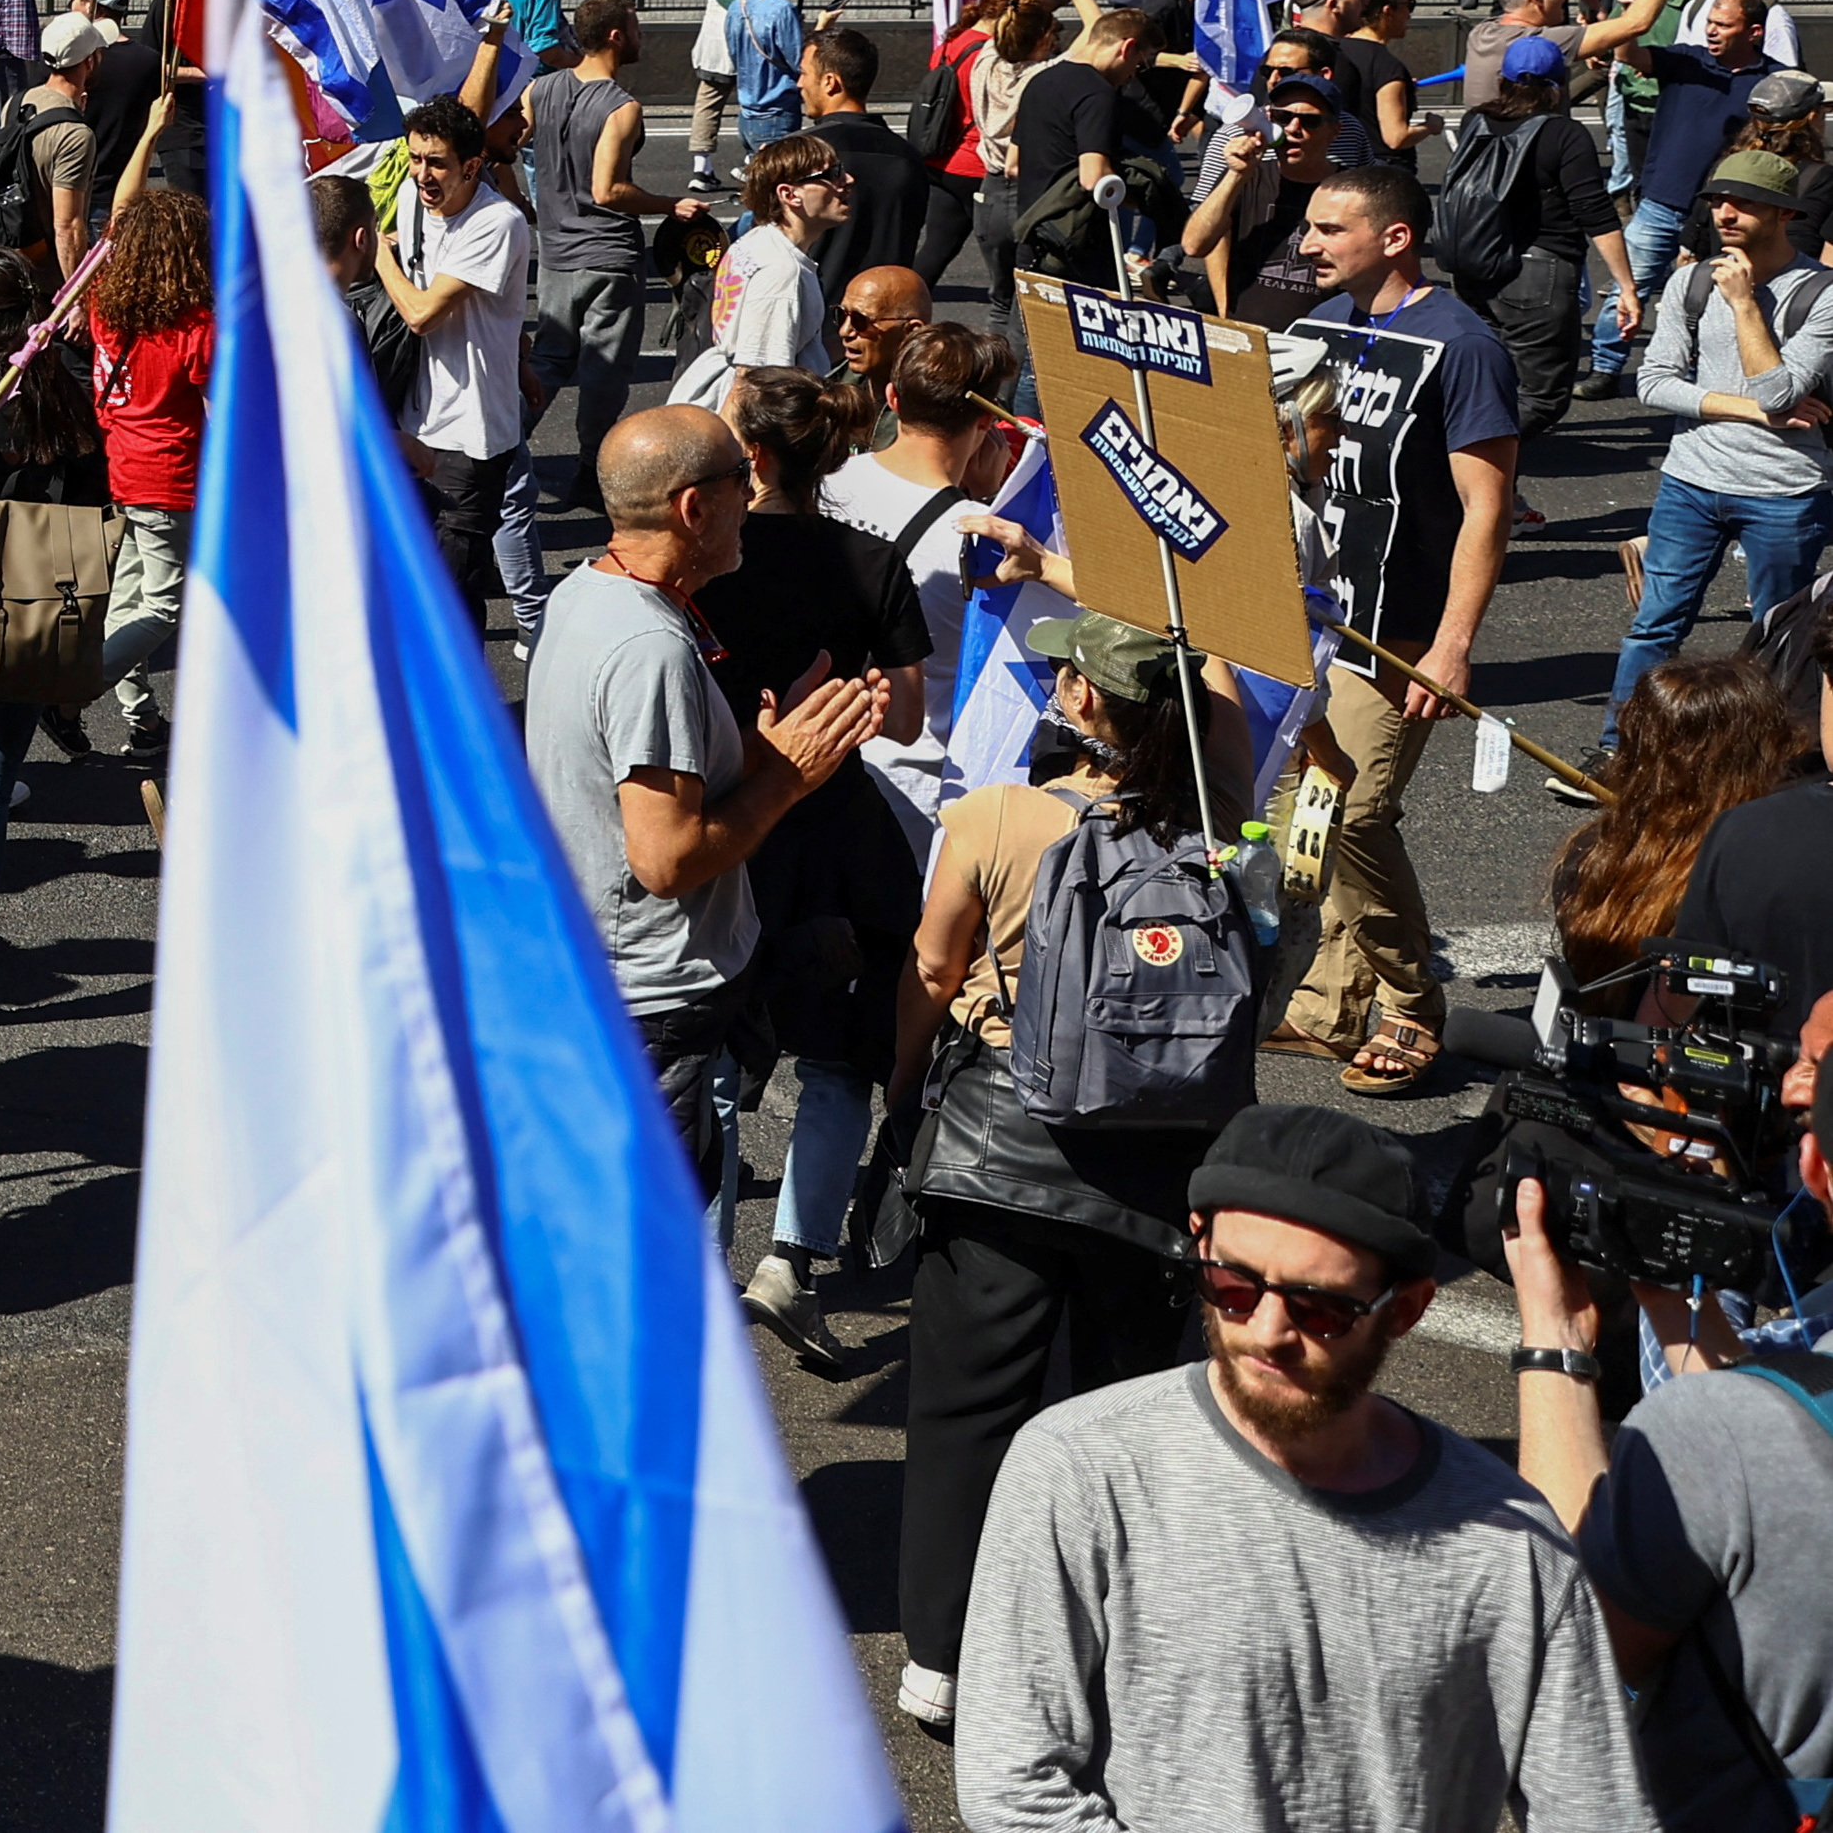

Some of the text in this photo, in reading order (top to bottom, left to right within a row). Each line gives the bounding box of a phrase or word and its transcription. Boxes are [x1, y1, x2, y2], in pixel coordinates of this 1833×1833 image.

[1257, 277, 1287, 290] ТЕЛЬ
[1072, 294, 1201, 357] נאמנים
[1081, 330, 1202, 375] למגילת העצמאות
[1089, 432, 1199, 550] למגילת העצמאות
[1098, 410, 1218, 541] נאמנים
